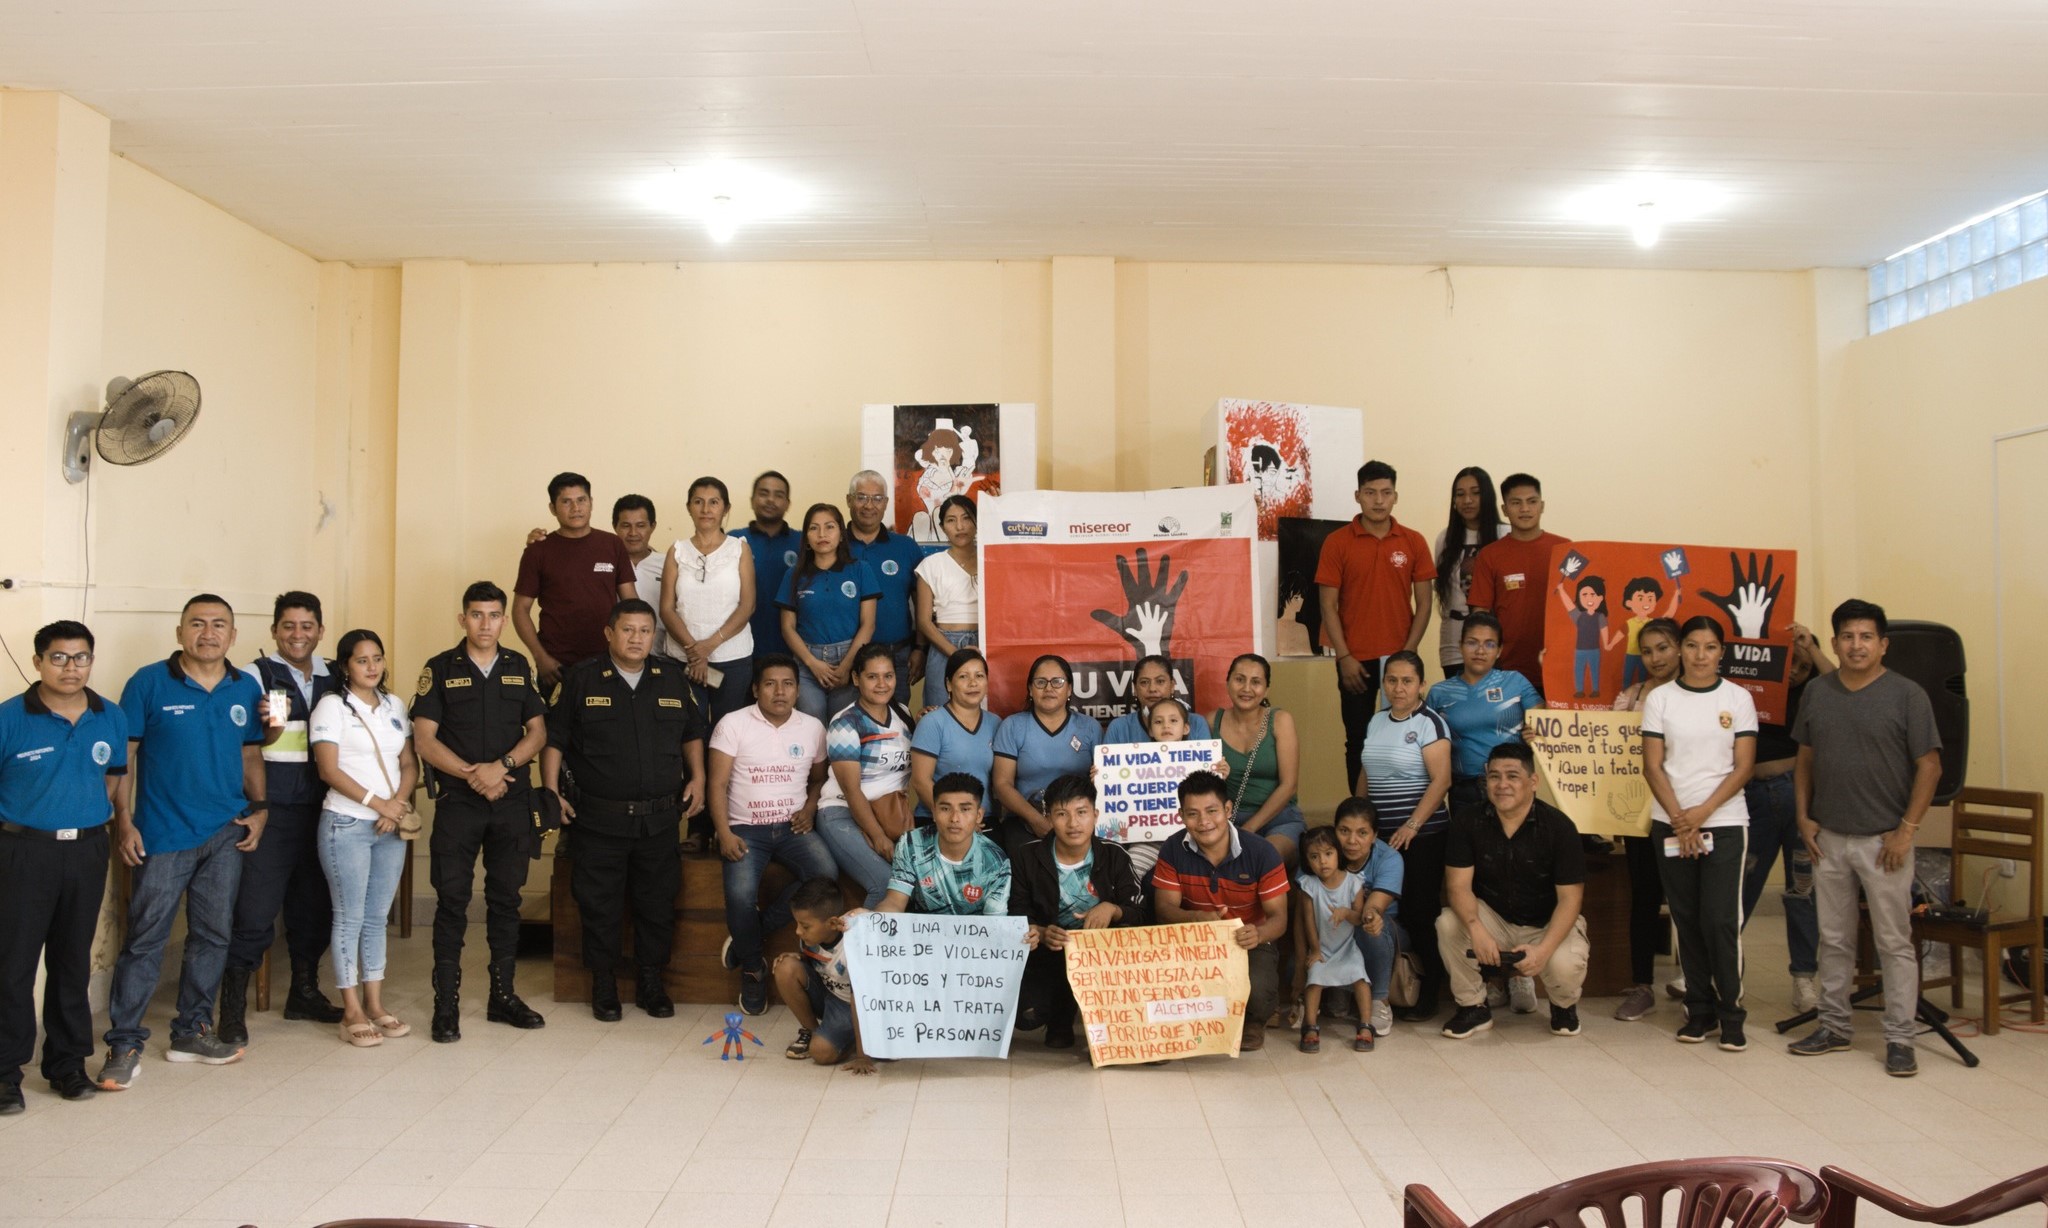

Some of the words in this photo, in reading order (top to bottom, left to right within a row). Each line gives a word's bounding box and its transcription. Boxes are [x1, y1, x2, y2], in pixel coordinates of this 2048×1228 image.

[1069, 522, 1132, 534] misereor
[1734, 644, 1771, 662] VIDA
[1730, 666, 1758, 676] PRECIO
[1072, 671, 1098, 699] U
[1082, 703, 1127, 718] TIENE
[1568, 712, 1609, 743] dejes
[1618, 724, 1642, 743] que
[1587, 744, 1596, 754] a
[1600, 739, 1624, 755] tus
[880, 752, 889, 766] 5
[1103, 754, 1121, 767] MI
[1125, 751, 1162, 766] VIDA
[1168, 750, 1213, 763] TIENE
[1593, 759, 1605, 775] la
[1610, 758, 1640, 775] trata
[751, 774, 793, 784] MATERNA
[1135, 765, 1187, 780] VALOR
[1104, 784, 1121, 796] MI
[1126, 781, 1181, 796] CUERP
[747, 799, 775, 809] AMOR
[777, 798, 795, 807] QUE
[1104, 800, 1129, 813] NO
[1133, 797, 1177, 811] TIENE
[752, 809, 784, 818] NUTRE
[912, 921, 941, 935] UNA
[954, 924, 989, 938] VIDA
[1069, 931, 1097, 949] TU
[1100, 929, 1141, 948] VIDA
[1143, 928, 1153, 945] Y
[865, 944, 906, 957] LIBRE
[913, 943, 934, 957] DE
[944, 944, 1024, 961] VIOLENCIA
[1068, 949, 1102, 971] SON
[881, 970, 929, 986] TODOS
[941, 973, 948, 988] Y
[956, 973, 1004, 989] TODAS
[1072, 971, 1100, 987] SER
[1101, 968, 1154, 988] HUMANO
[1205, 966, 1224, 980] LA
[1073, 989, 1121, 1006] VENTA
[1122, 988, 1141, 1004] NO
[1142, 984, 1201, 1002] SEAMOS
[862, 994, 915, 1013] CONTRA
[924, 1000, 942, 1012] LA
[953, 1000, 1004, 1014] TRATA
[1135, 1007, 1145, 1022] Y
[1153, 1001, 1214, 1016] ALCEMOS
[887, 1026, 905, 1040] DE
[914, 1022, 1002, 1043] PERSONAS
[1107, 1023, 1135, 1042] POR
[1137, 1025, 1158, 1042] LOS
[1160, 1024, 1185, 1039] QUE
